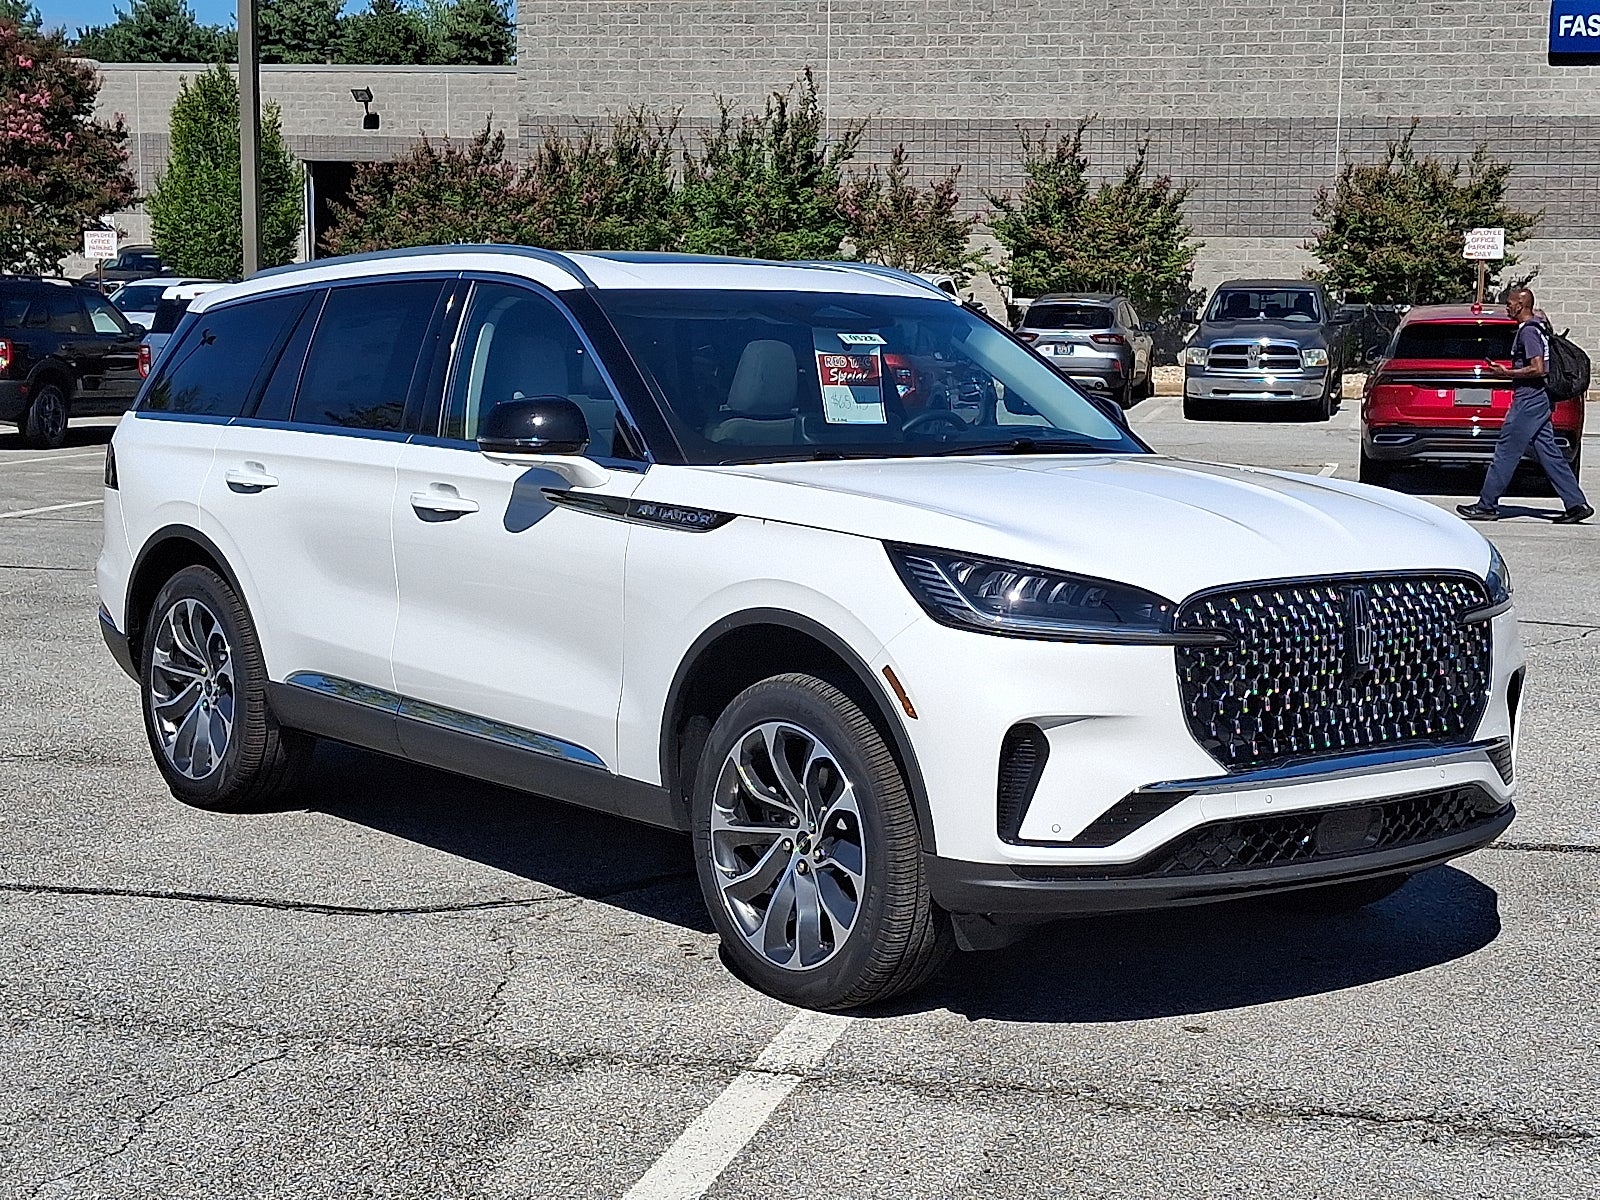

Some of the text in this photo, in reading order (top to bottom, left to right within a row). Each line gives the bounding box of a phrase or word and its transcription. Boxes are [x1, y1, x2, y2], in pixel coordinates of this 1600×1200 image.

[1558, 14, 1600, 37] FAS
[824, 356, 848, 368] RED
[636, 505, 714, 525] AVIATOR
